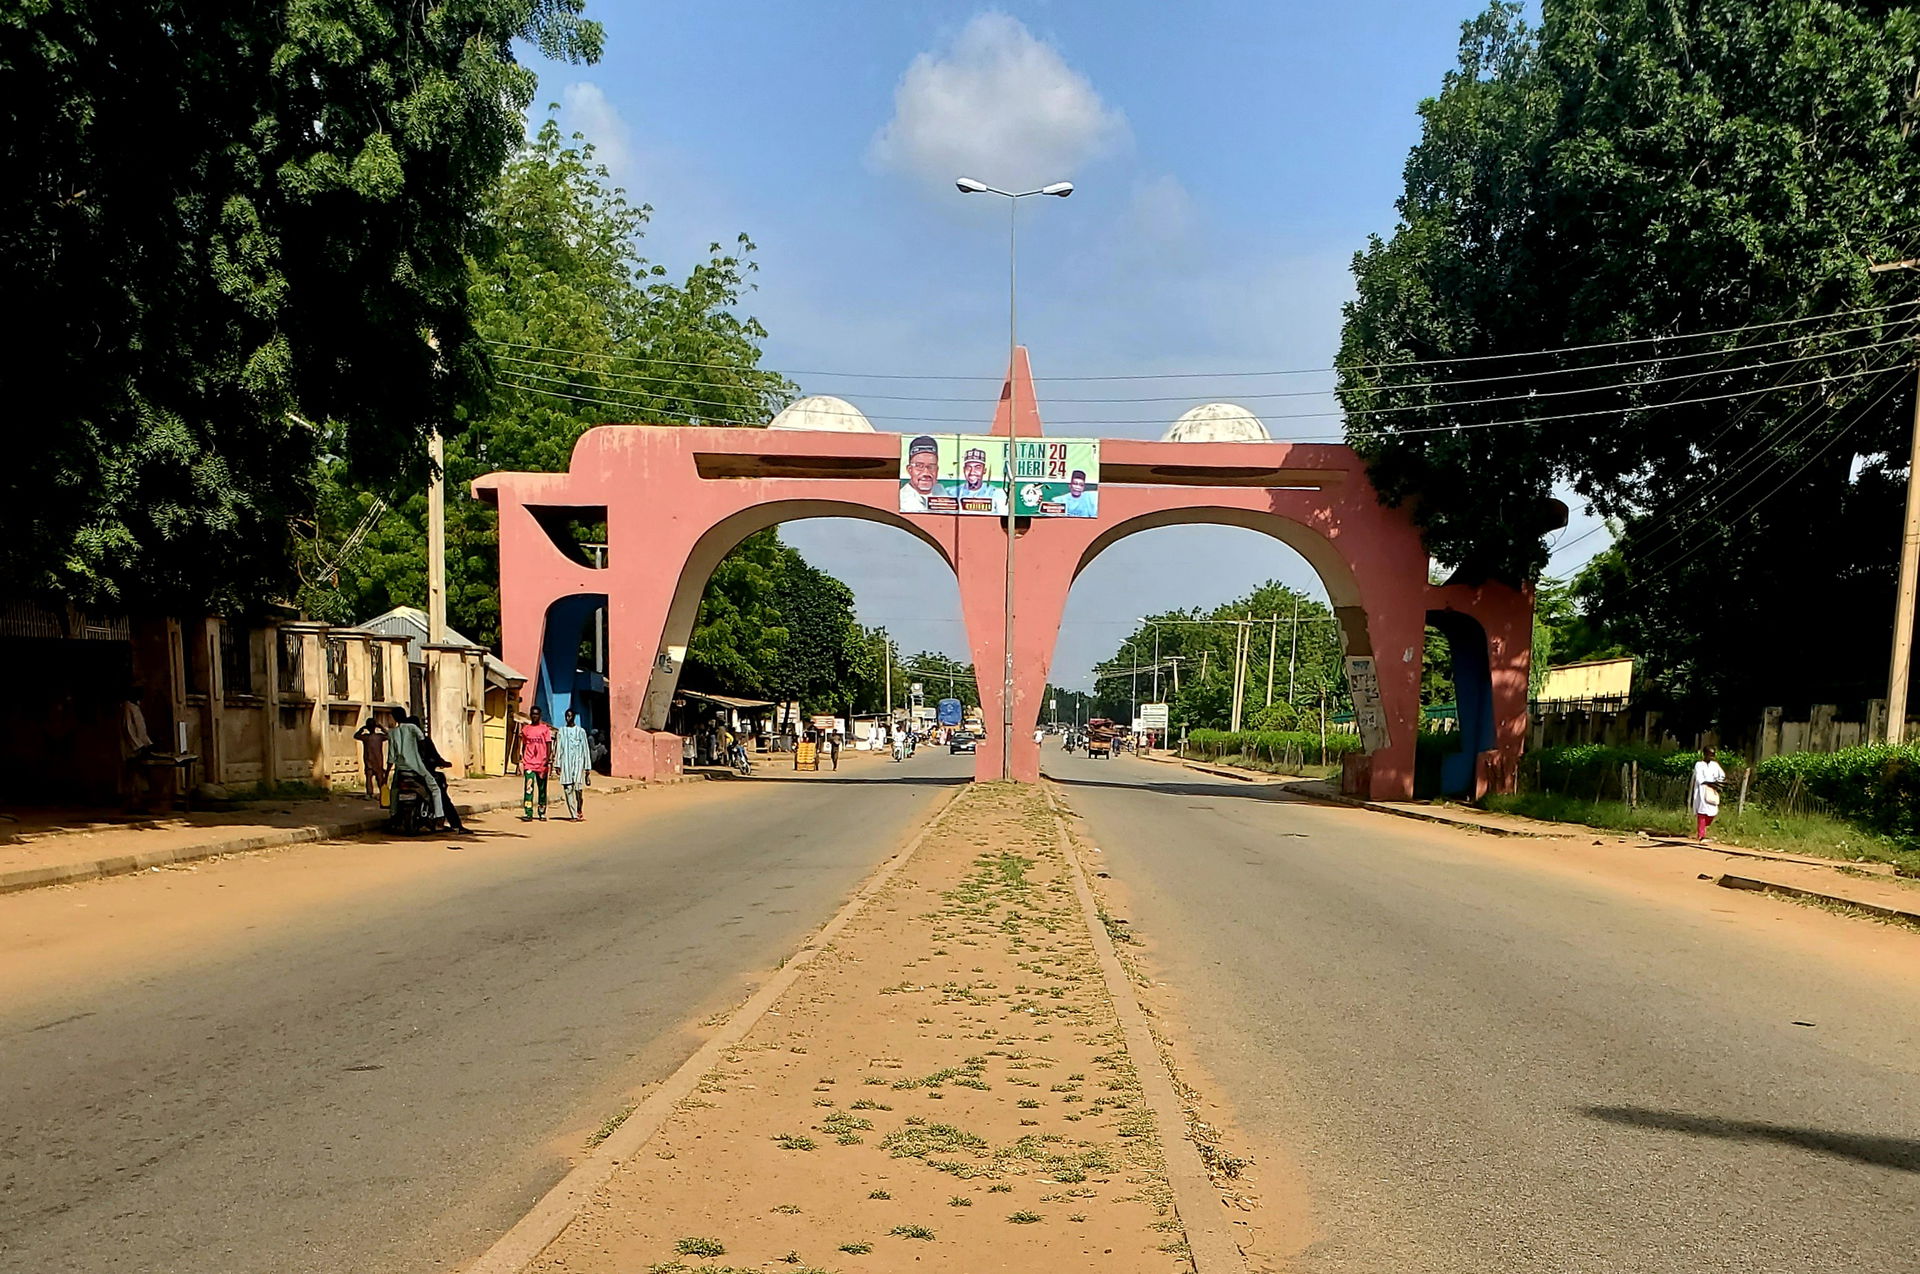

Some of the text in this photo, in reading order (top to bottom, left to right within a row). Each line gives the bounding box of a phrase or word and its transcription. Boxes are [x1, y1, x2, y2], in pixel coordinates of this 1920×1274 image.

[1004, 443, 1067, 460] FTAN 20
[1004, 461, 1066, 477] AHERI 24
